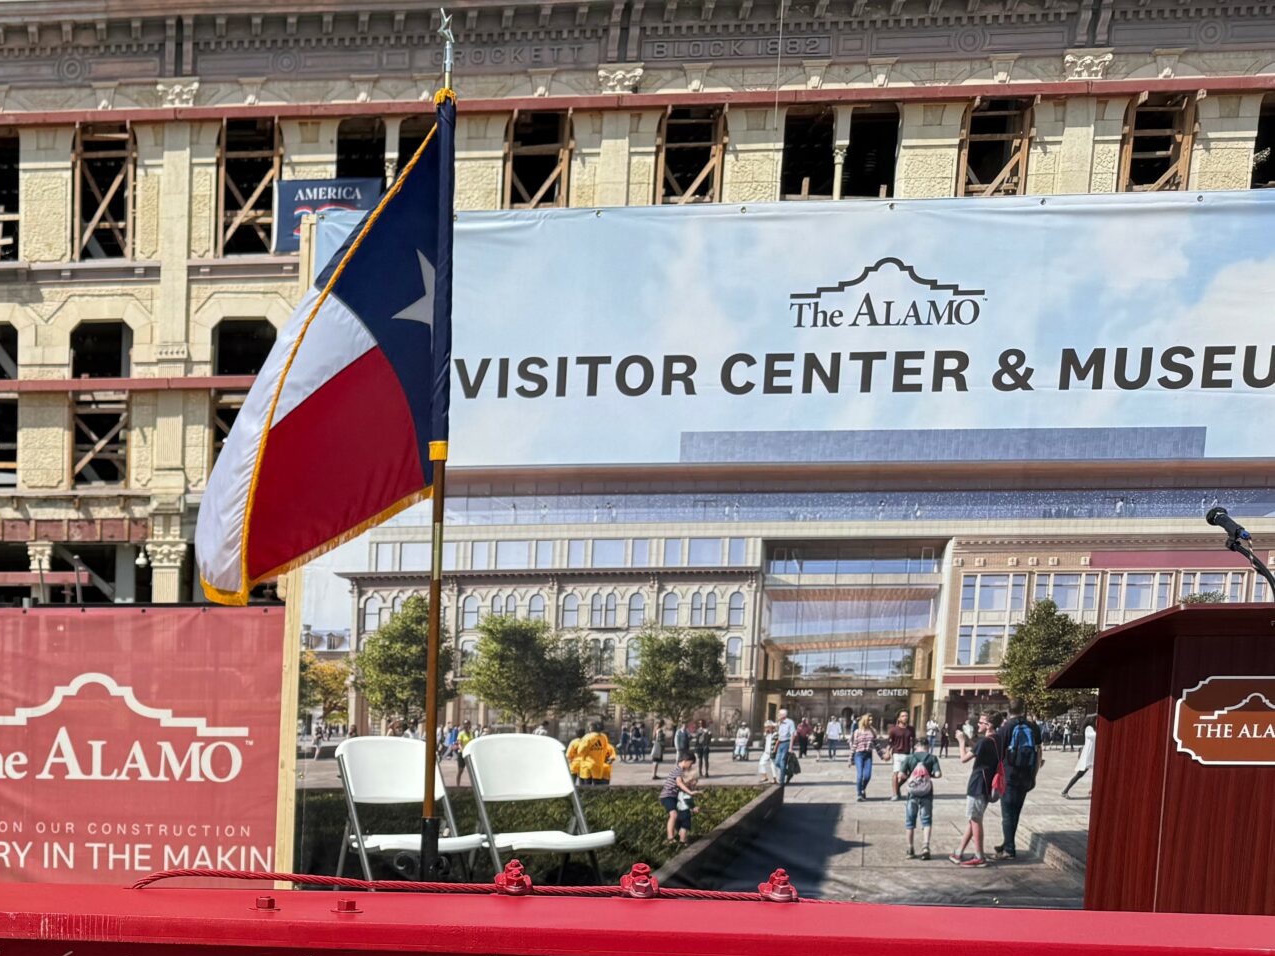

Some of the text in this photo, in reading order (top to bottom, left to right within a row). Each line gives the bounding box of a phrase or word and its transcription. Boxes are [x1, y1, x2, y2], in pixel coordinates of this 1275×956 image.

[653, 37, 821, 58] BLOCK 1882
[294, 186, 362, 201] AMERICA
[789, 292, 981, 328] The ALAMO
[453, 345, 1275, 399] VISITOR CENTER & MUSEU
[786, 689, 909, 697] ALAMO VISITOR CENTER
[1192, 723, 1275, 738] THE ALA
[35, 726, 243, 783] ALAMO
[35, 822, 75, 834] OUR
[87, 822, 251, 837] CONSTRUCTION
[42, 842, 75, 869] IN
[84, 842, 153, 871] THE
